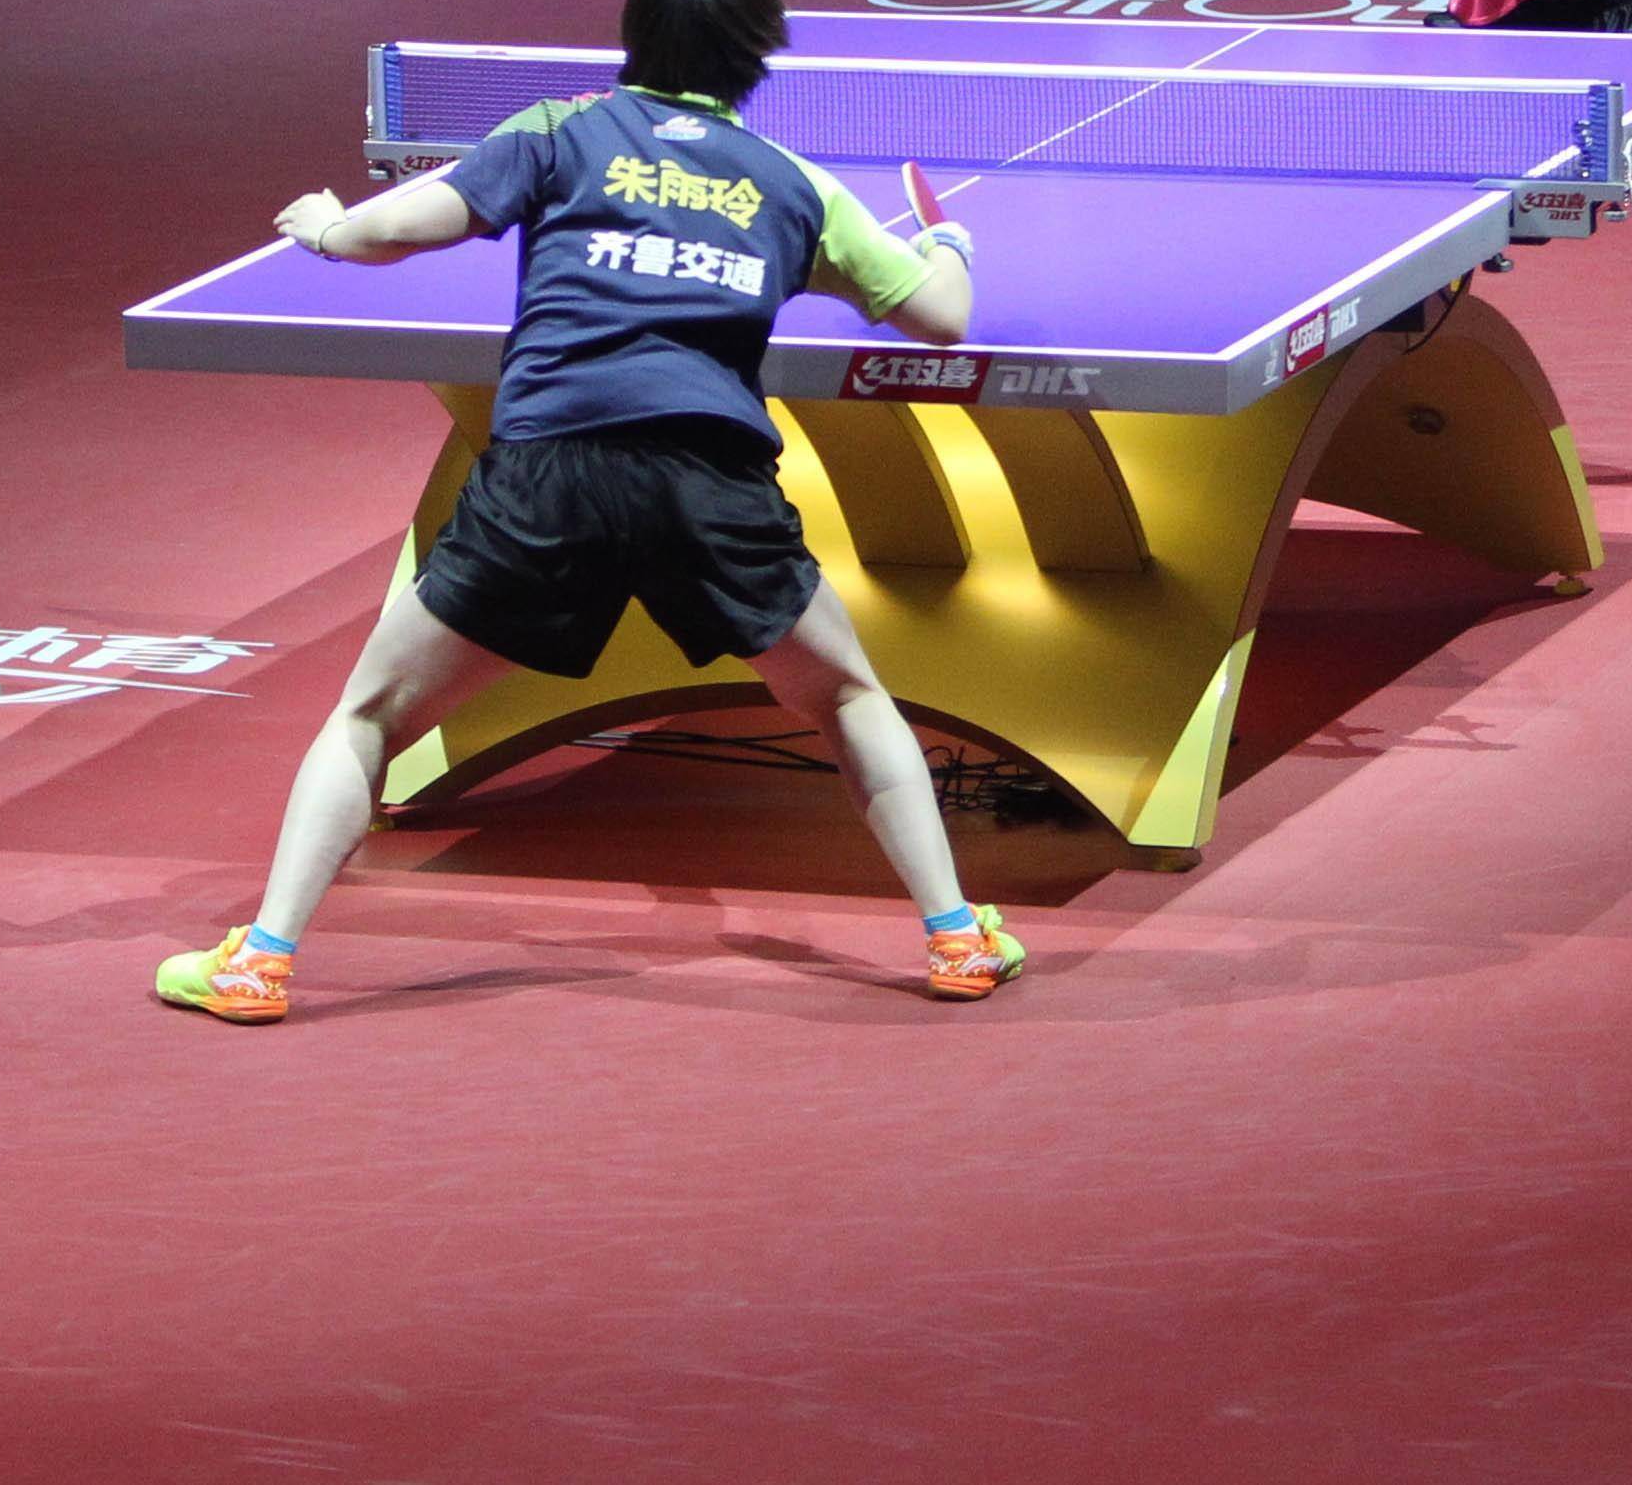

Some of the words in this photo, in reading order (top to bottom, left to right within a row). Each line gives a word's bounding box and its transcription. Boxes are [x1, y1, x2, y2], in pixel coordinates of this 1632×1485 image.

[602, 154, 765, 231] 朱雨玲
[1518, 191, 1587, 213] 红双喜
[1547, 210, 1584, 222] DHS
[586, 231, 767, 297] 齐鲁交通
[852, 355, 979, 396] 红双喜
[995, 363, 1101, 396] DHS
